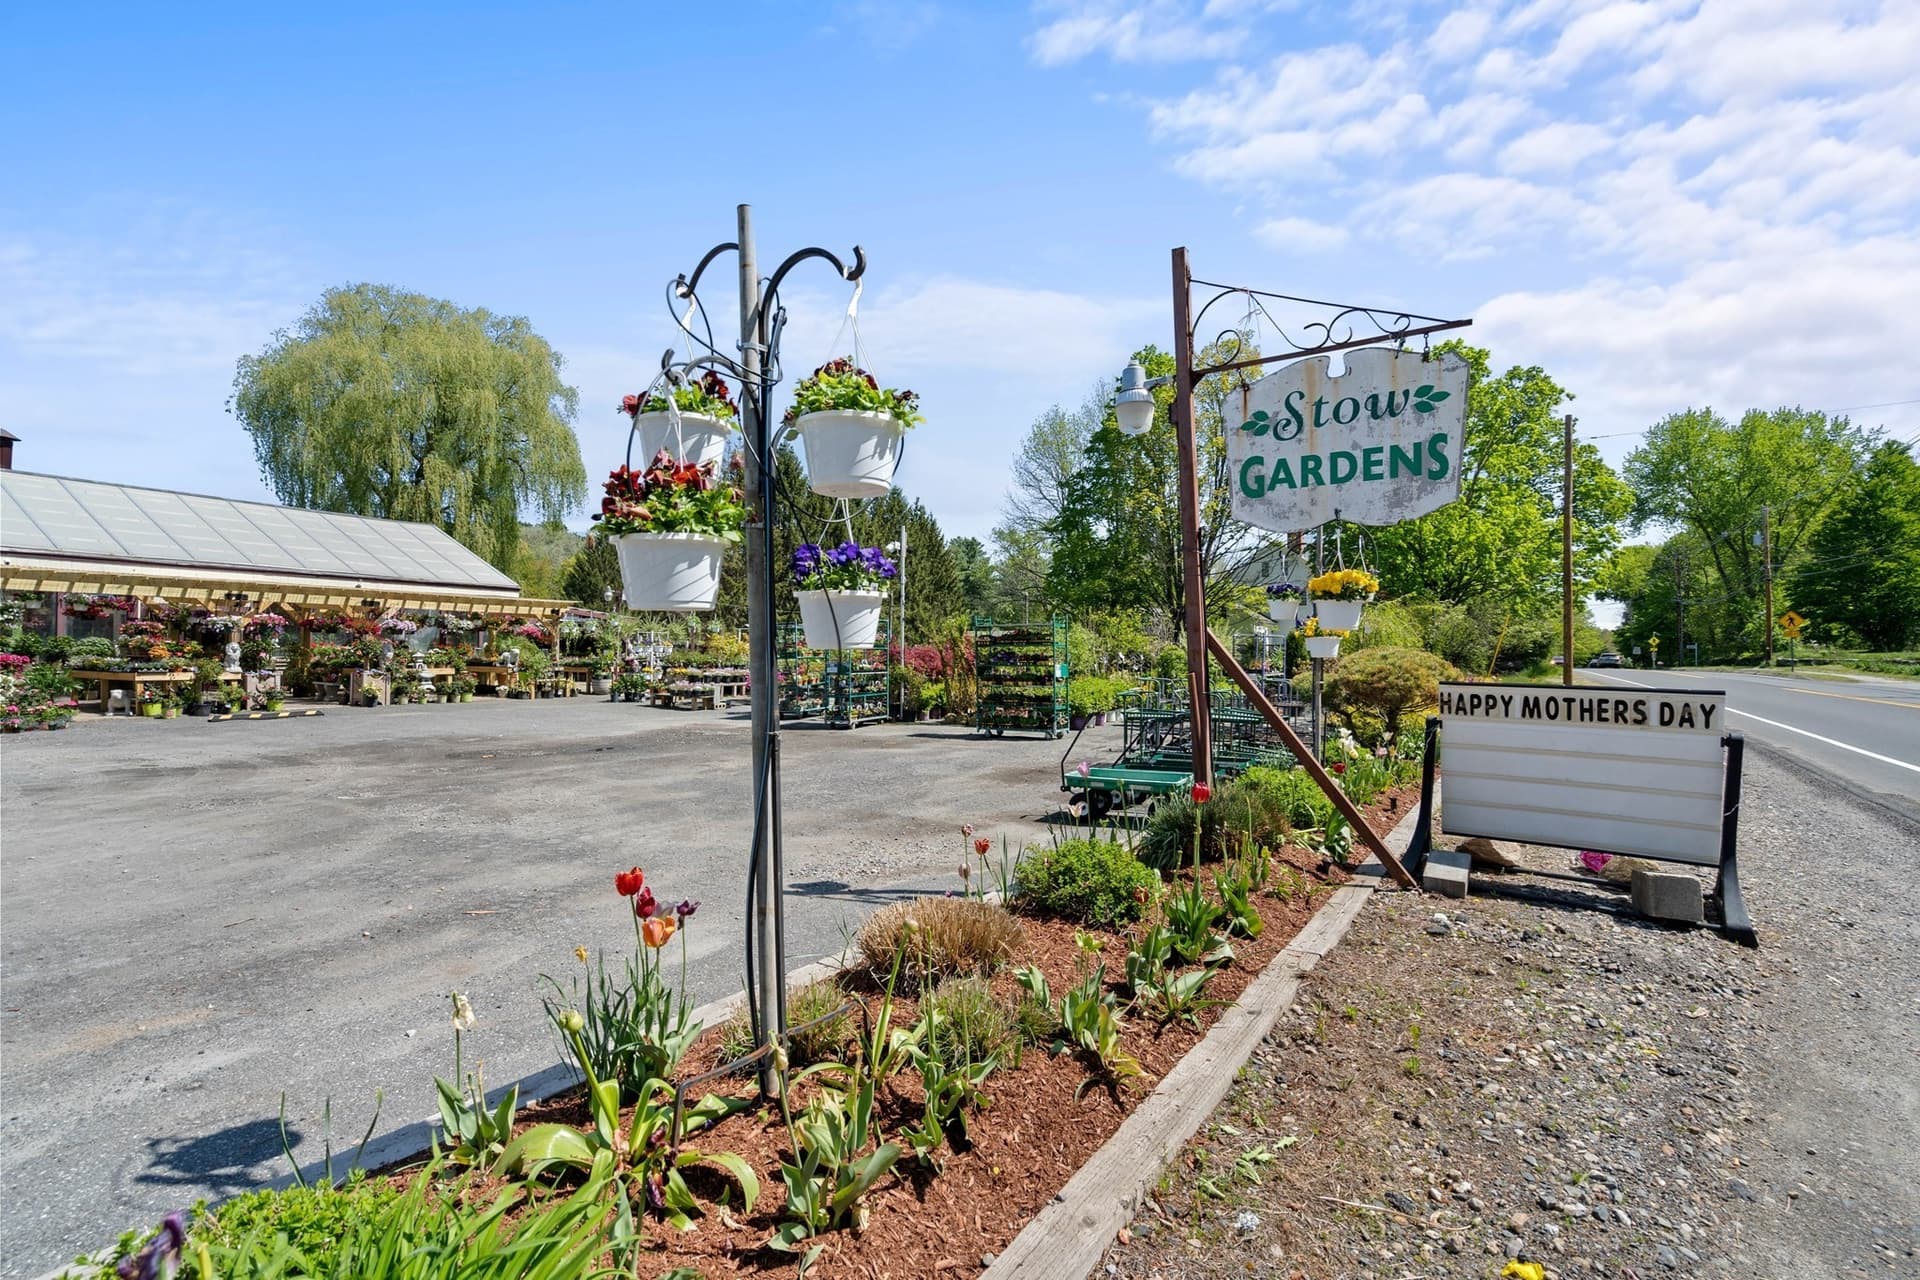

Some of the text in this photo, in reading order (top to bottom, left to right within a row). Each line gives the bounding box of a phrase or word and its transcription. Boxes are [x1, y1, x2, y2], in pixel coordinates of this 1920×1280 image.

[1273, 388, 1409, 441] Stow
[1239, 432, 1450, 498] GARDENS
[1440, 692, 1716, 729] HAPPY MOTHERS DAY
